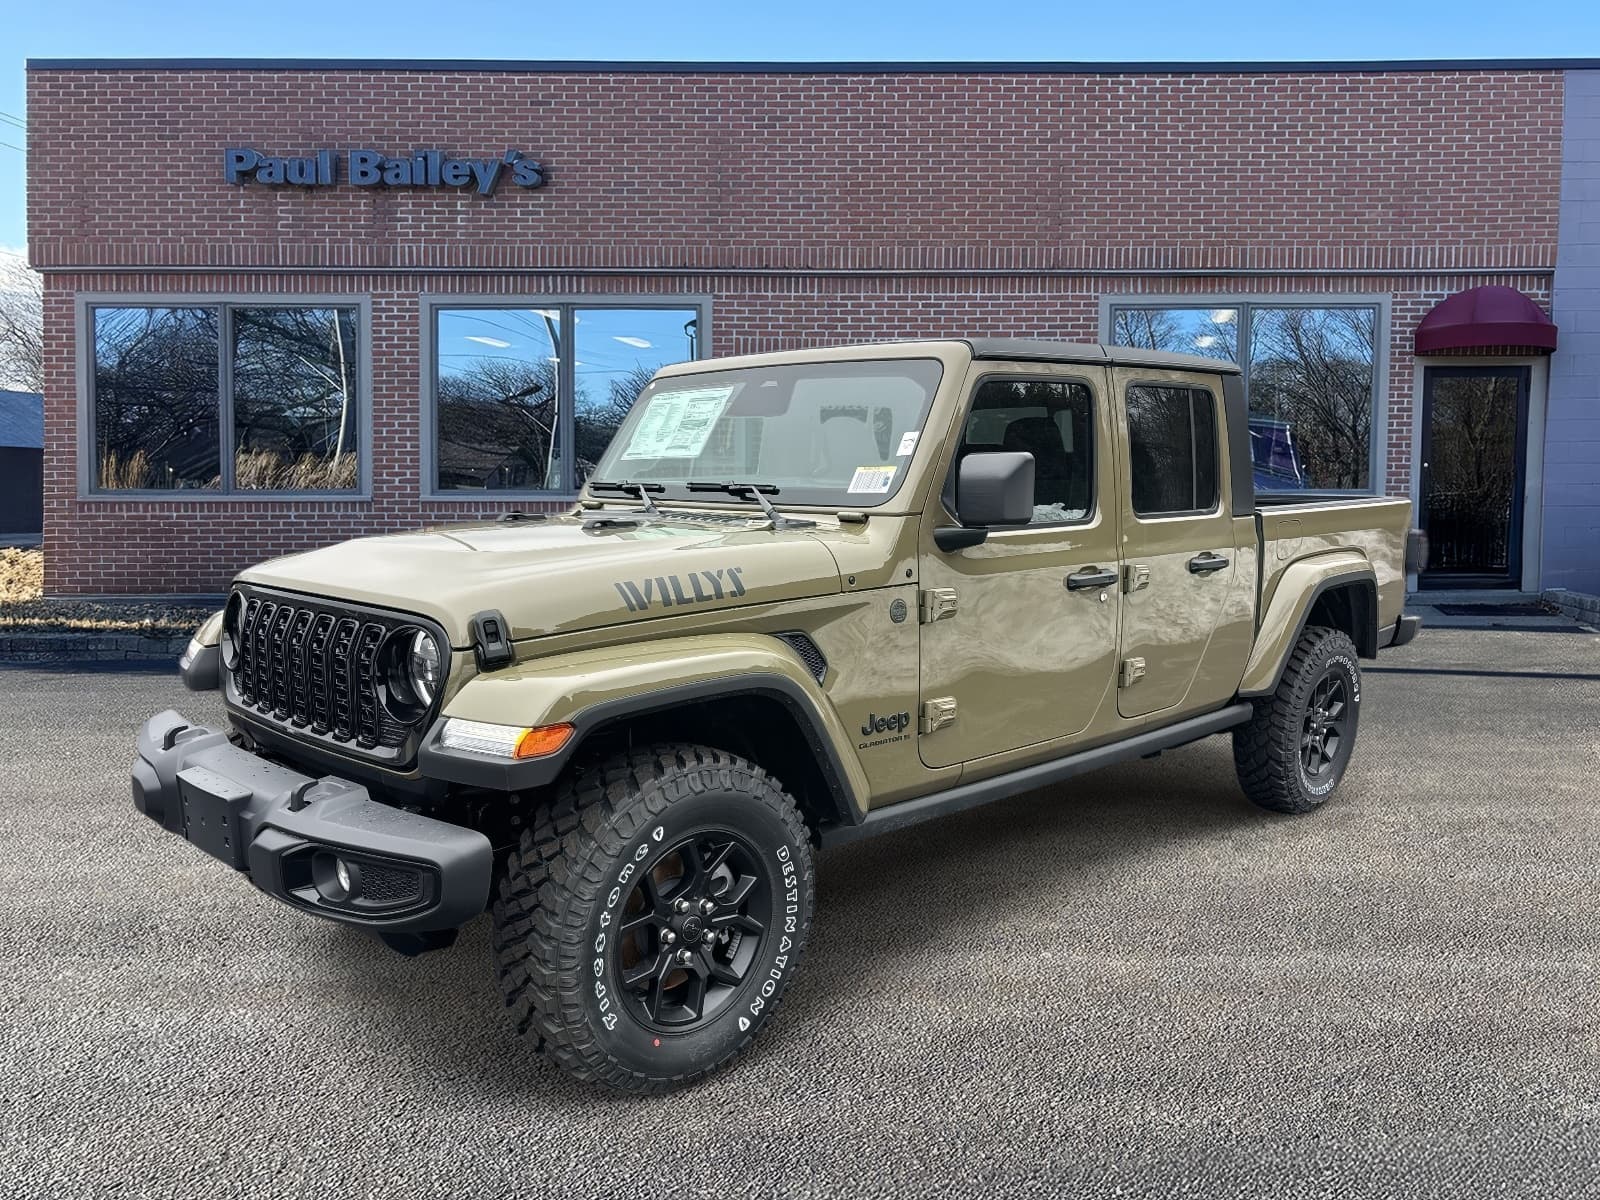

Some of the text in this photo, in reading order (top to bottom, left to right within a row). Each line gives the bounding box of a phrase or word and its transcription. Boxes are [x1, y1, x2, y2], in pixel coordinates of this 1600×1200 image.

[225, 148, 546, 197] Paul Bailey's
[614, 567, 747, 613] WILLYS
[861, 711, 910, 736] Jeep
[749, 845, 799, 1016] DESTINATION
